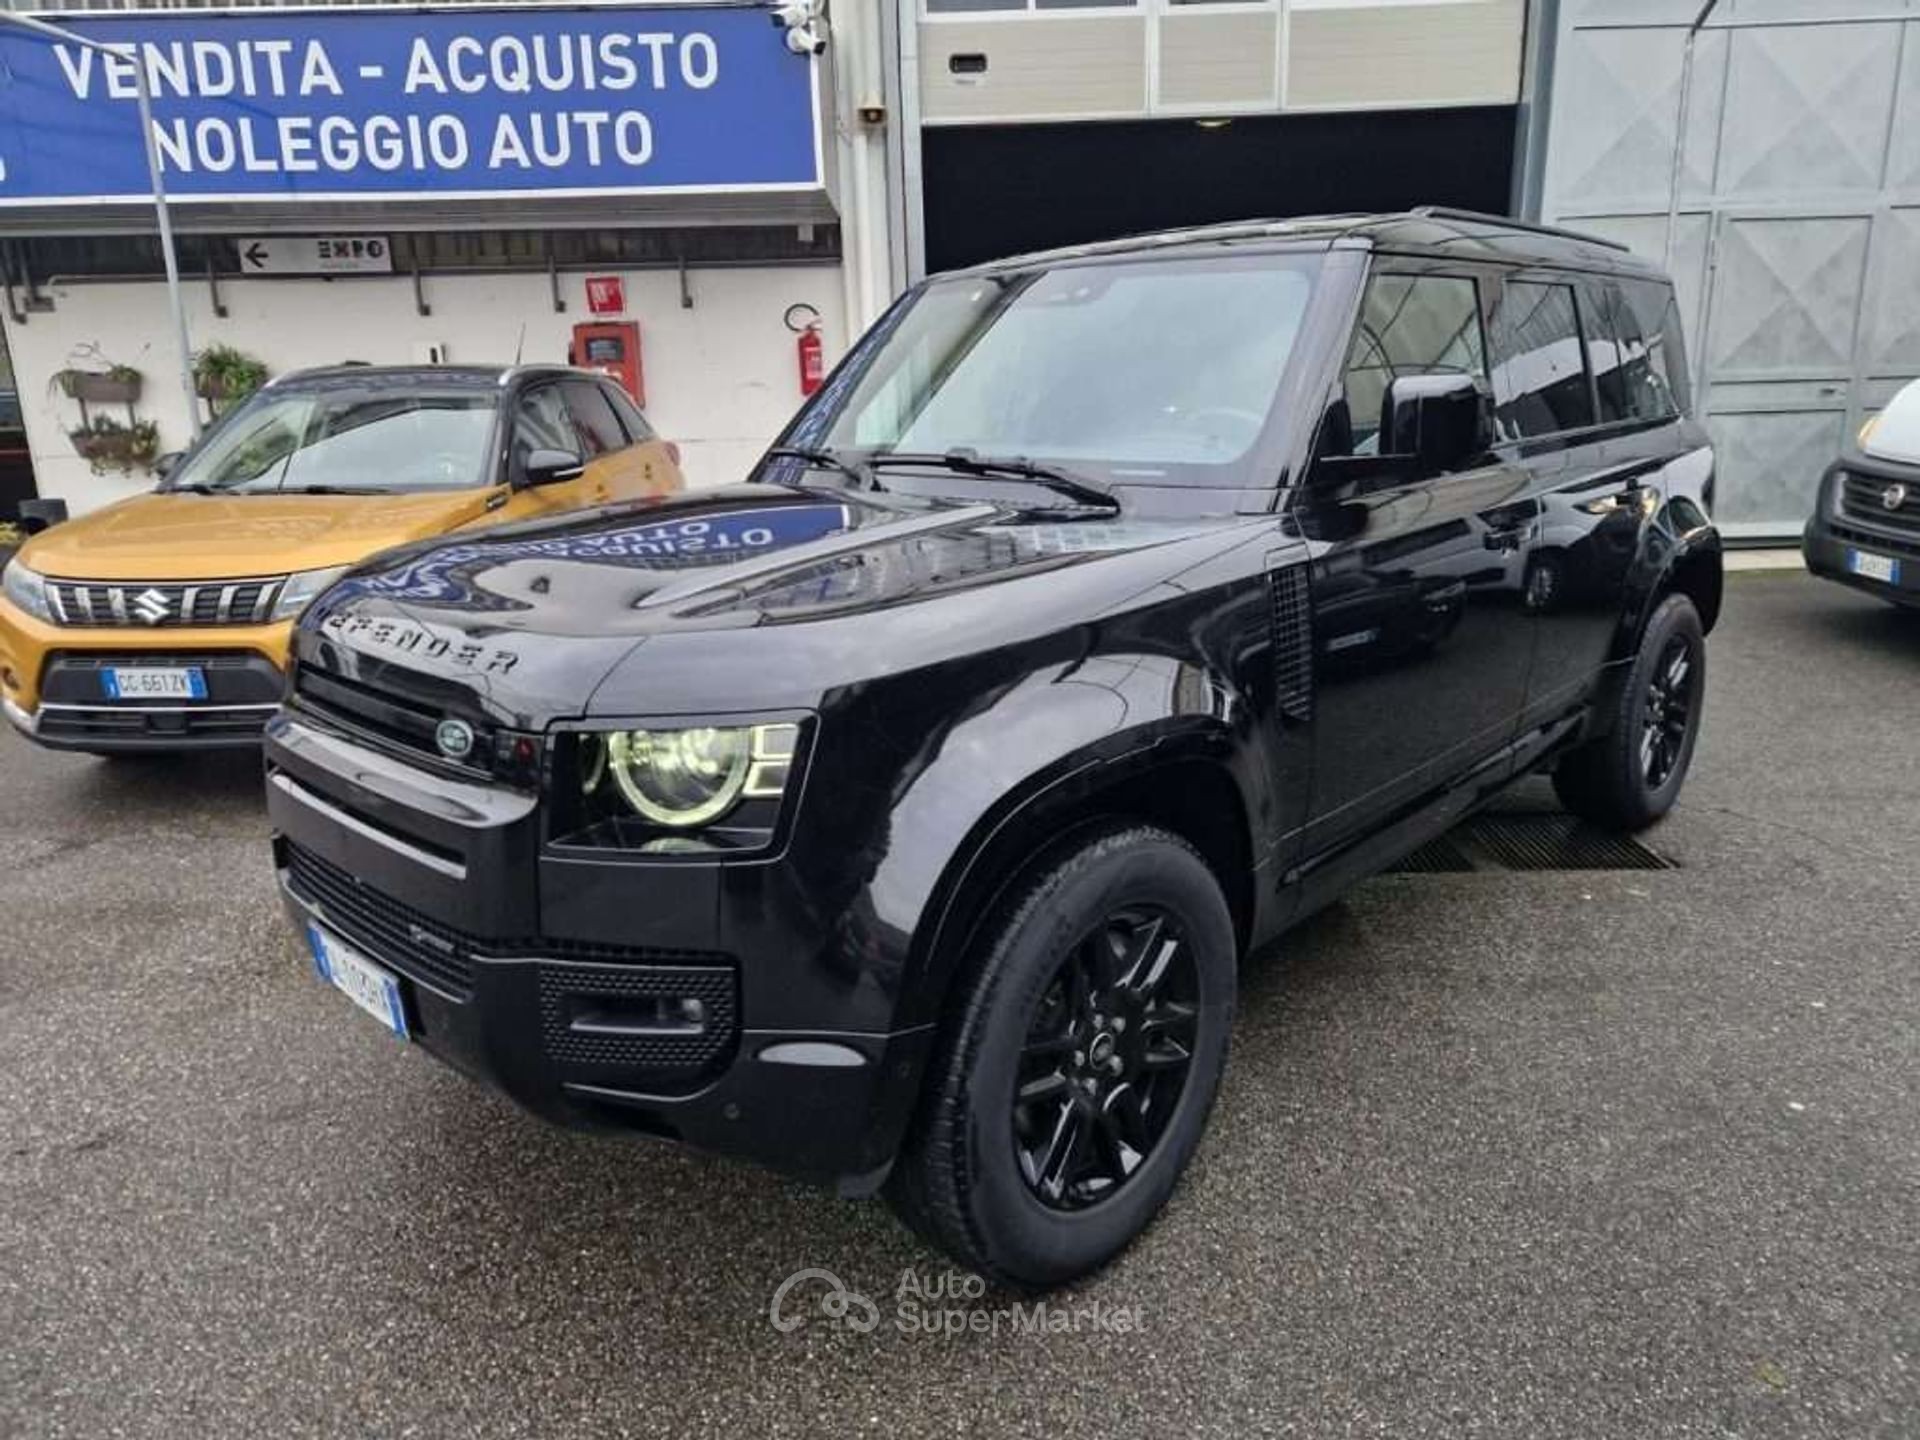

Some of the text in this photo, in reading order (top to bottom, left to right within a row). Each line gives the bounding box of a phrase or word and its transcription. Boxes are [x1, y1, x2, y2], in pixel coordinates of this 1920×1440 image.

[53, 39, 343, 99] VENDITA
[404, 32, 719, 93] ACQUISTO
[151, 110, 653, 173] NOLEGGIO AUTO
